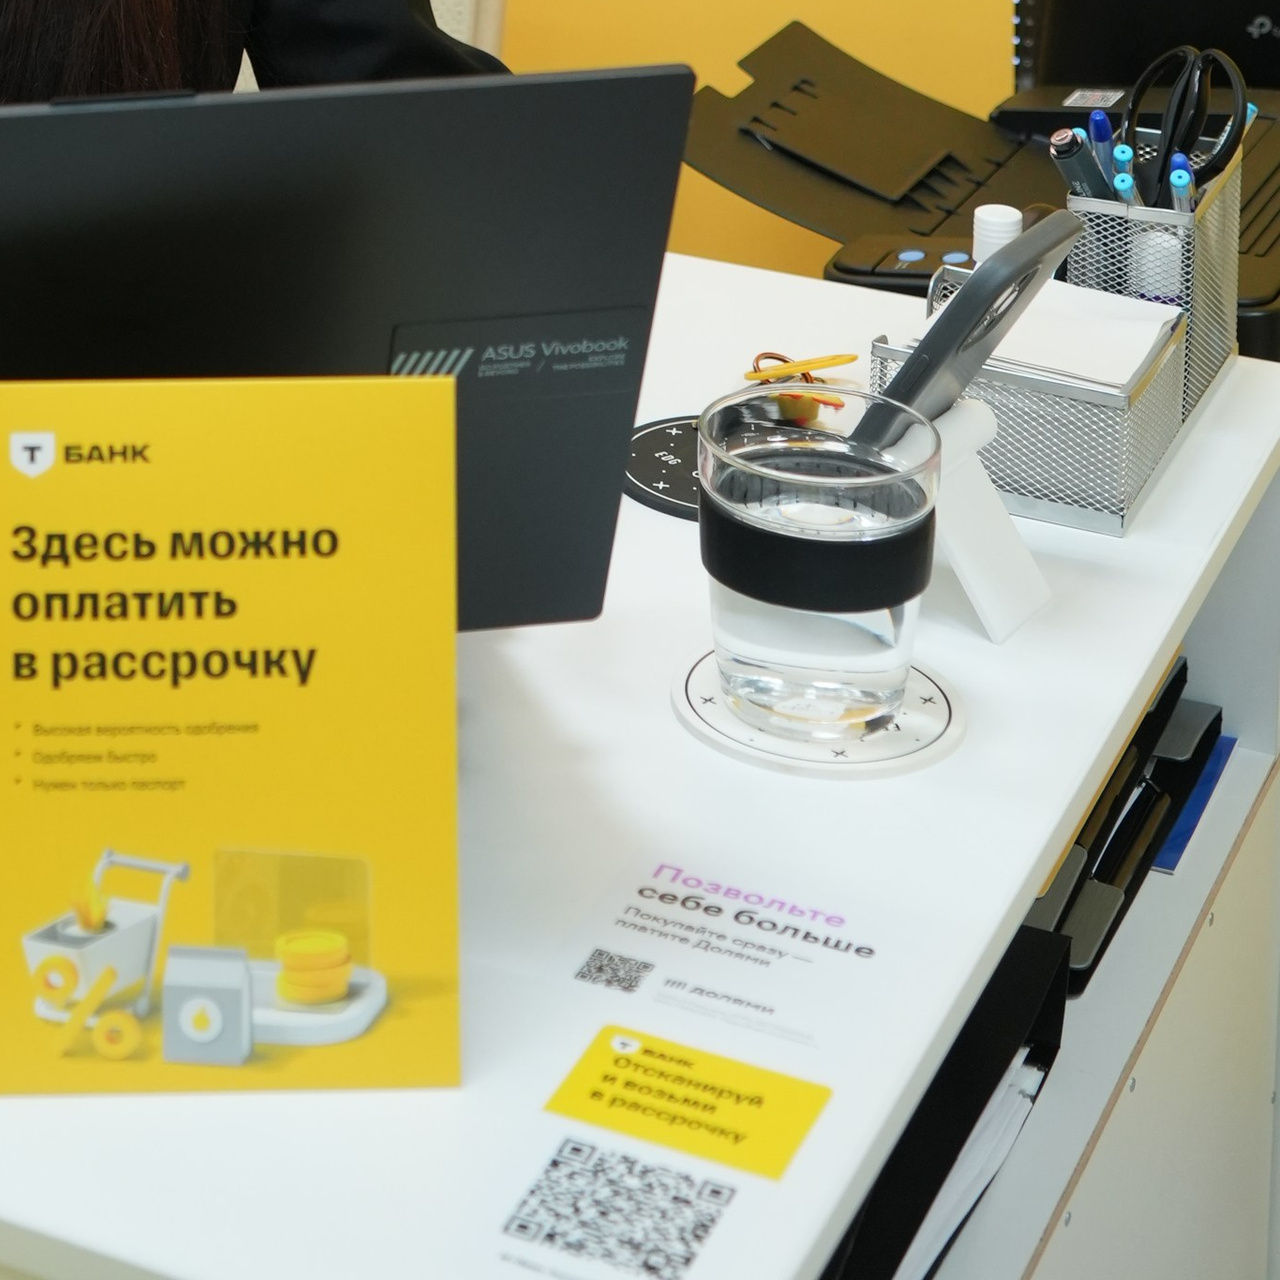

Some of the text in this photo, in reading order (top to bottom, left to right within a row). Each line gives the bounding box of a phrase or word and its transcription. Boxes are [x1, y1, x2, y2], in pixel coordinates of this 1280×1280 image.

[482, 336, 629, 361] ASUS Vivobook
[64, 445, 150, 464] БАНК
[12, 525, 339, 569] Здесь можно
[12, 590, 239, 622] оплатить
[12, 648, 318, 690] в рассрочку
[651, 863, 847, 928] Позвольте
[614, 919, 772, 969] платите Долями
[623, 905, 728, 941] Покупайте
[731, 936, 790, 960] сразу
[637, 885, 876, 959] себе больше
[689, 986, 776, 1016] долями
[601, 1073, 718, 1115] и возьми
[613, 1056, 765, 1109] Отсканируй
[589, 1089, 748, 1146] в рассрочку
